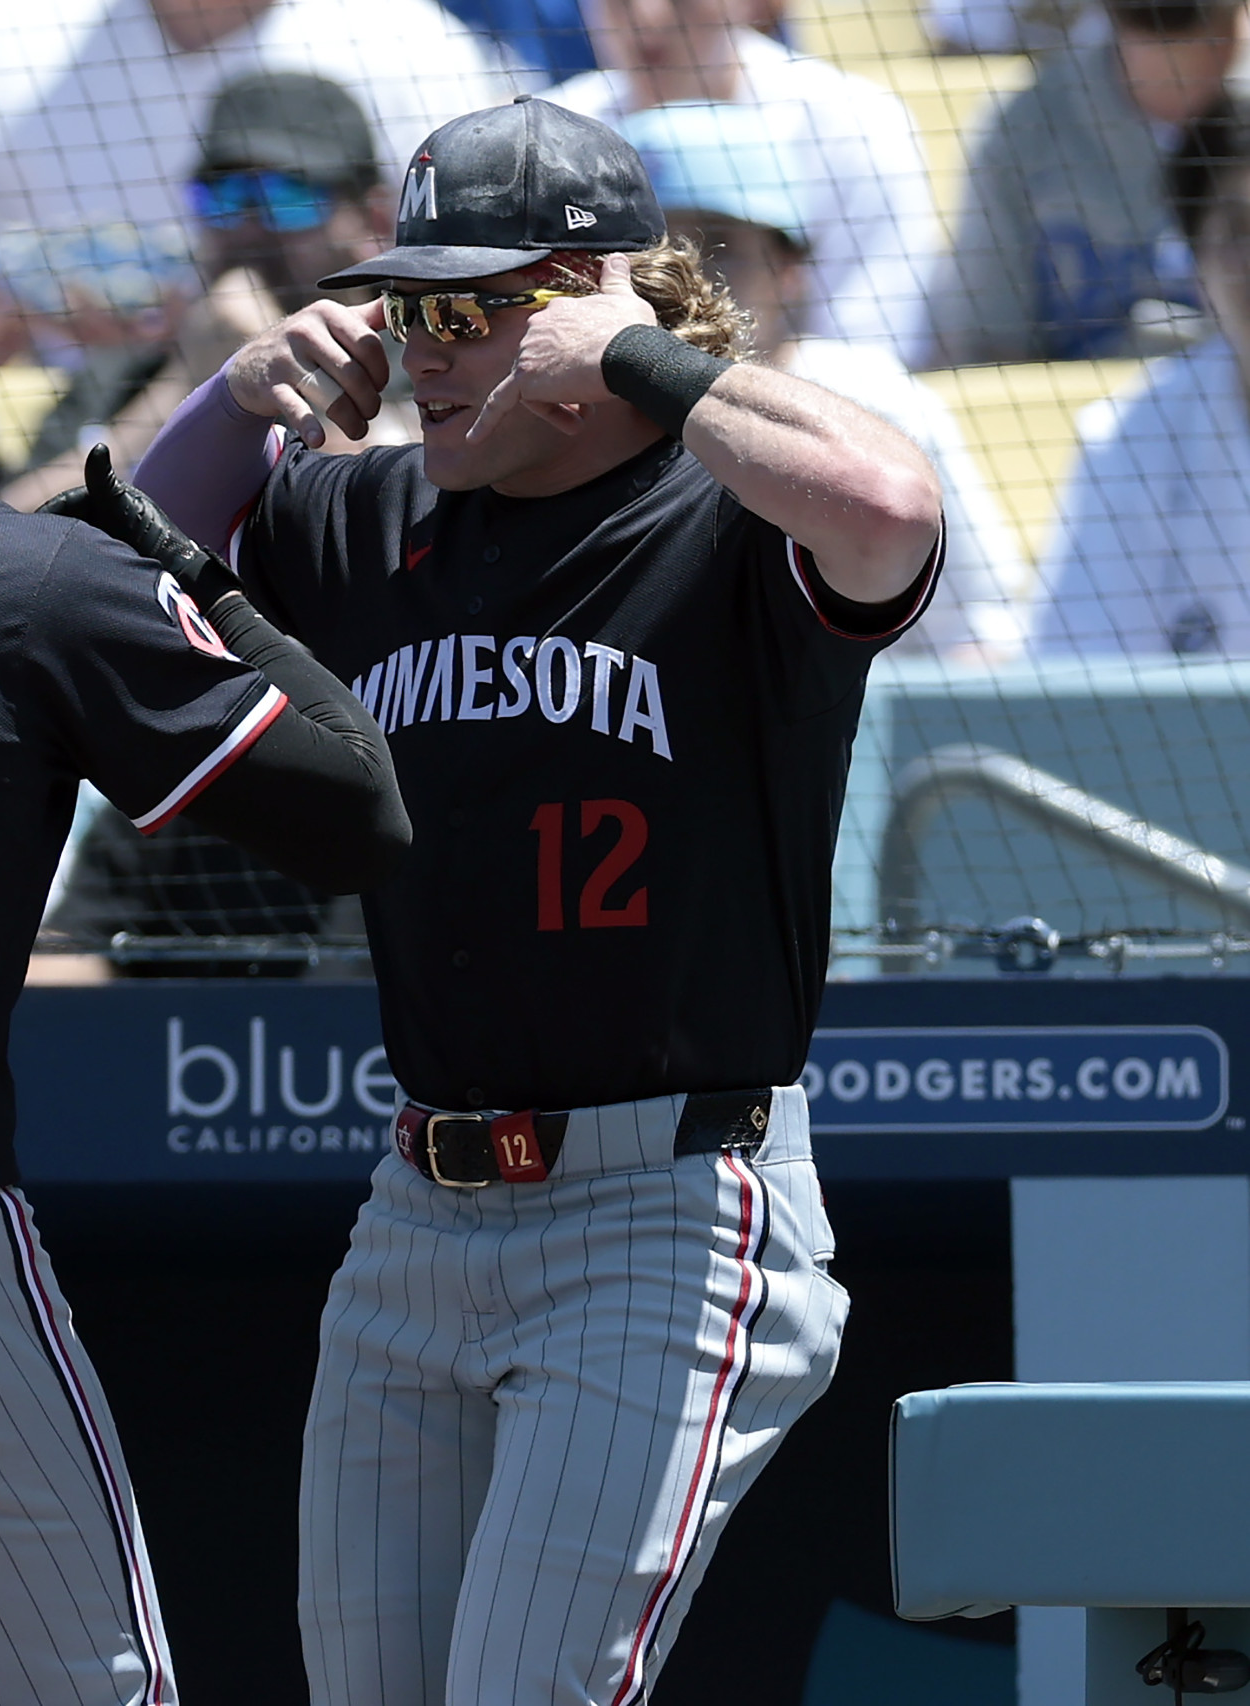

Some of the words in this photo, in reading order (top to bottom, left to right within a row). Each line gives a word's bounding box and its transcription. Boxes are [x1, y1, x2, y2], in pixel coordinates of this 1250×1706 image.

[527, 798, 650, 932] 12
[166, 1015, 400, 1117] blue
[500, 1133, 533, 1167] 12
